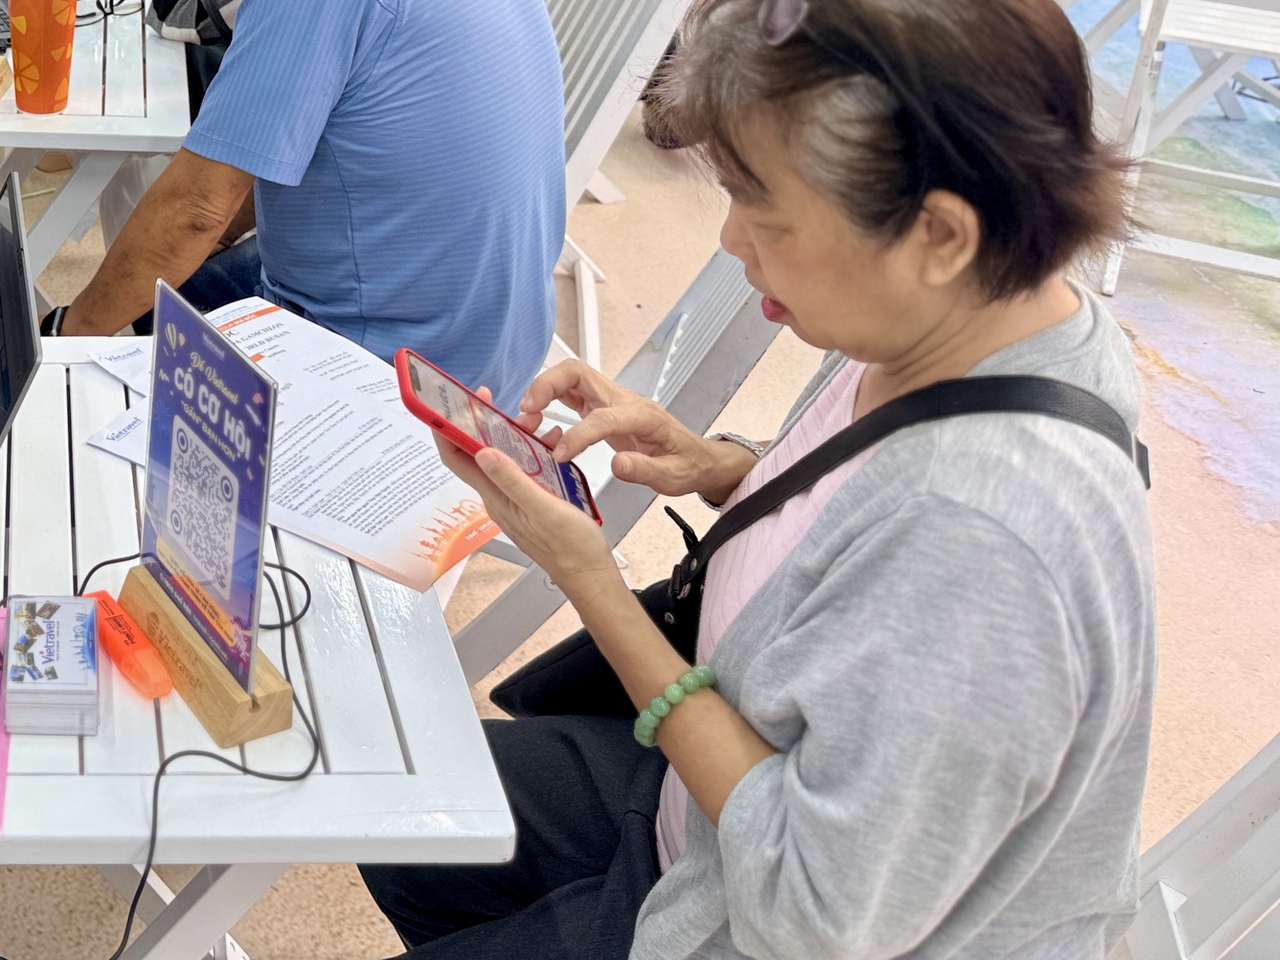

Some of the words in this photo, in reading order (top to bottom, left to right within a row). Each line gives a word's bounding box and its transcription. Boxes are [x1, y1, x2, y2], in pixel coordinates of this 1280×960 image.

[106, 417, 142, 441] Vietravel
[174, 366, 194, 399] CÓ
[198, 384, 220, 424] CƠ
[224, 409, 251, 461] HỘI
[39, 620, 56, 665] Vietravel
